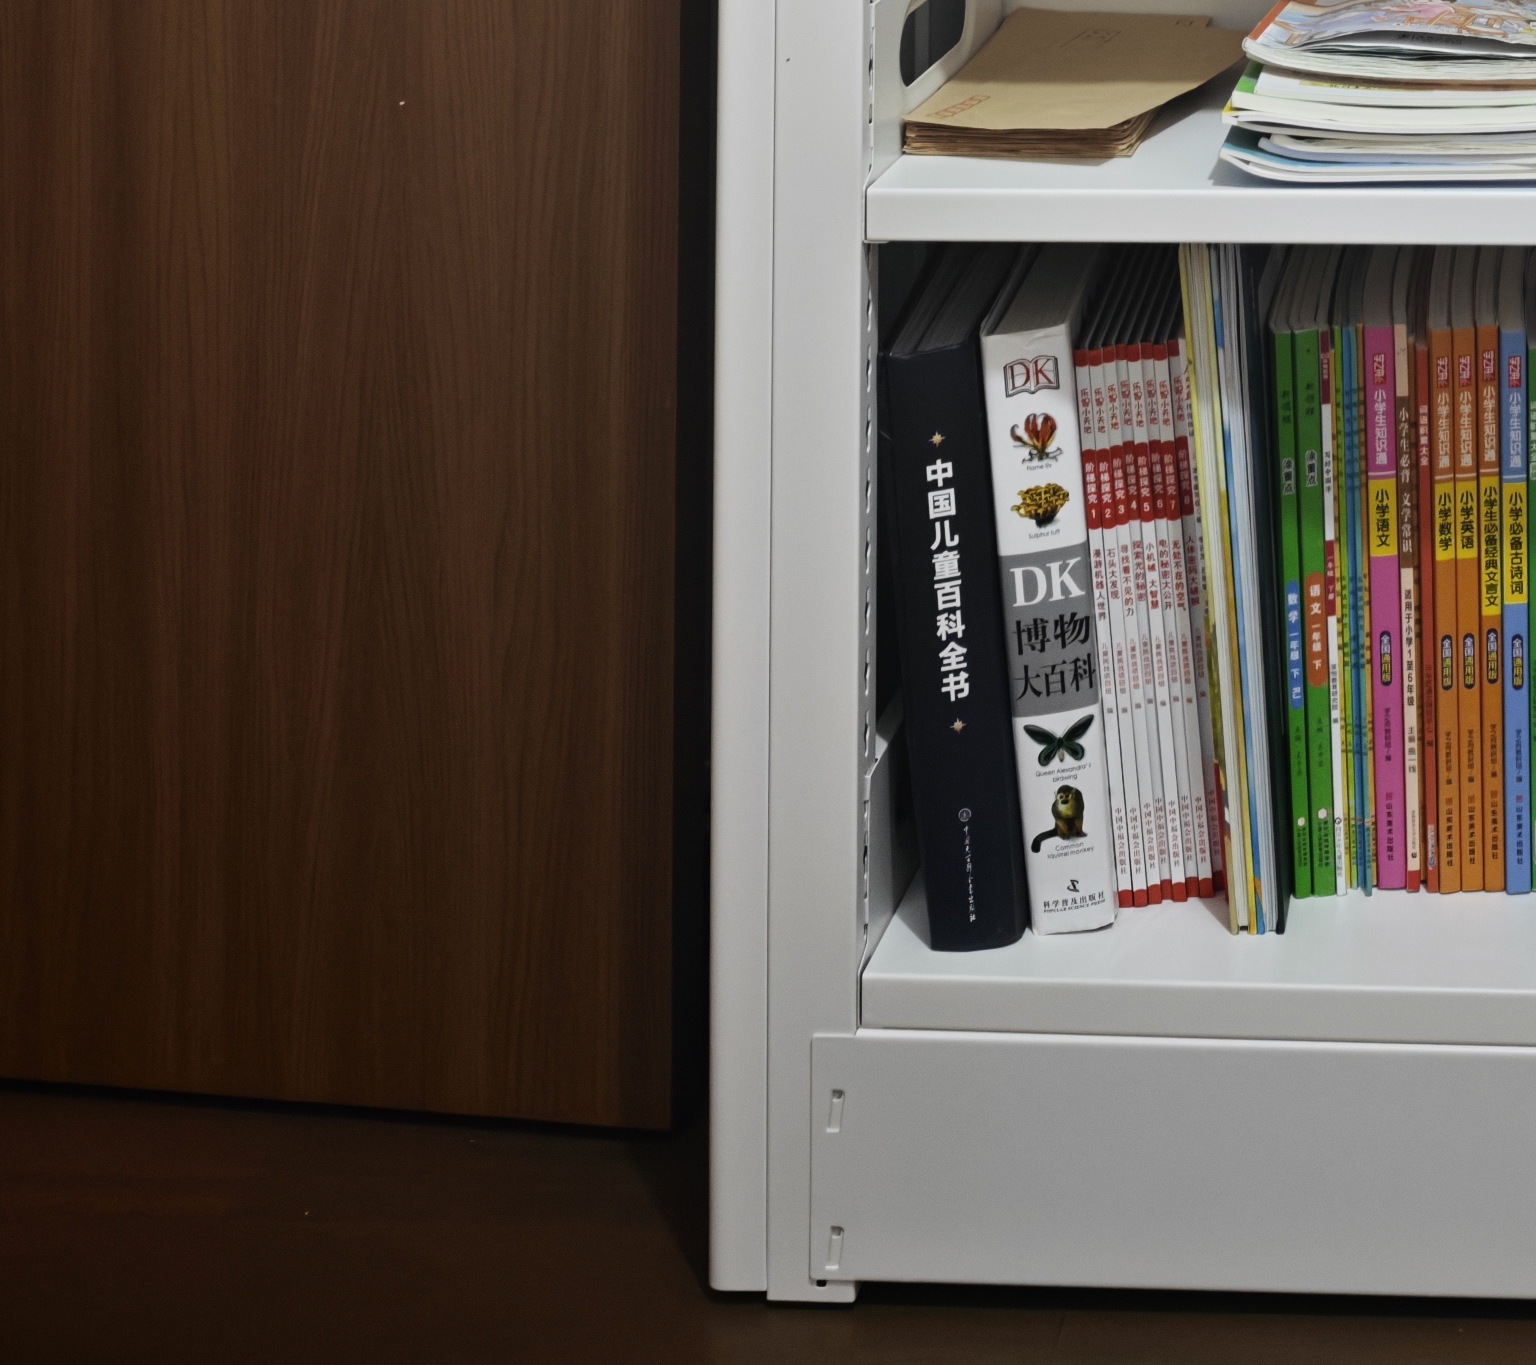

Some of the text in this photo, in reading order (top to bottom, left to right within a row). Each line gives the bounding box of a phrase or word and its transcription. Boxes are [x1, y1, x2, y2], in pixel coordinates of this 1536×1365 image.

[1009, 357, 1055, 391] DK
[1107, 384, 1120, 430] 乐智小天地
[1120, 380, 1132, 426] 乐智小天地
[1080, 388, 1093, 434] 乐智小天地
[1094, 388, 1106, 434] 乐智小天地
[1373, 388, 1387, 465] 小学生知识通
[1436, 391, 1450, 468] 小学生知识通
[1459, 390, 1473, 467] 小学生知识通
[1483, 385, 1496, 462] 小学生知识通
[1509, 391, 1522, 468] 小学生知识通
[1112, 458, 1126, 500] 阶梯探究
[1399, 407, 1411, 484] 小学生必背
[1085, 462, 1098, 504] 阶梯探究
[1099, 462, 1112, 503] 阶梯探究
[1375, 488, 1390, 548] 小学语文
[1438, 491, 1452, 551] 小学数学
[1459, 490, 1474, 549] 小学英语
[1483, 485, 1498, 607] 小学生必备经典文言文
[1508, 491, 1524, 595] 小学必备古诗词
[926, 458, 970, 702] 中国儿童百科全书
[1010, 556, 1085, 608] DK
[1092, 549, 1106, 621] 漫游机器人世界
[1106, 548, 1120, 600] 石头大发现
[1120, 544, 1134, 617] 寻找看不见的力
[1132, 540, 1146, 602] 探索光的秘密
[1145, 542, 1159, 610] 小机械 大智慧
[1158, 539, 1173, 611] 电的秘密大公开
[1172, 539, 1186, 611] 无处不在的空气
[1012, 611, 1091, 656] 博物
[1286, 592, 1300, 661] 数学 一年级
[1309, 584, 1322, 652] 语文 一年级
[1404, 588, 1415, 706] 适用于小学1至6年级
[1013, 652, 1097, 702] 大百科
[1055, 841, 1085, 852] Common
[1069, 846, 1095, 858] monkey
[1115, 807, 1128, 875] 中国中福会出版社
[1129, 806, 1142, 874] 中国中福会出版社
[1143, 802, 1156, 869] 中国中福会出版社
[1043, 890, 1105, 909] 科学普及出版社
